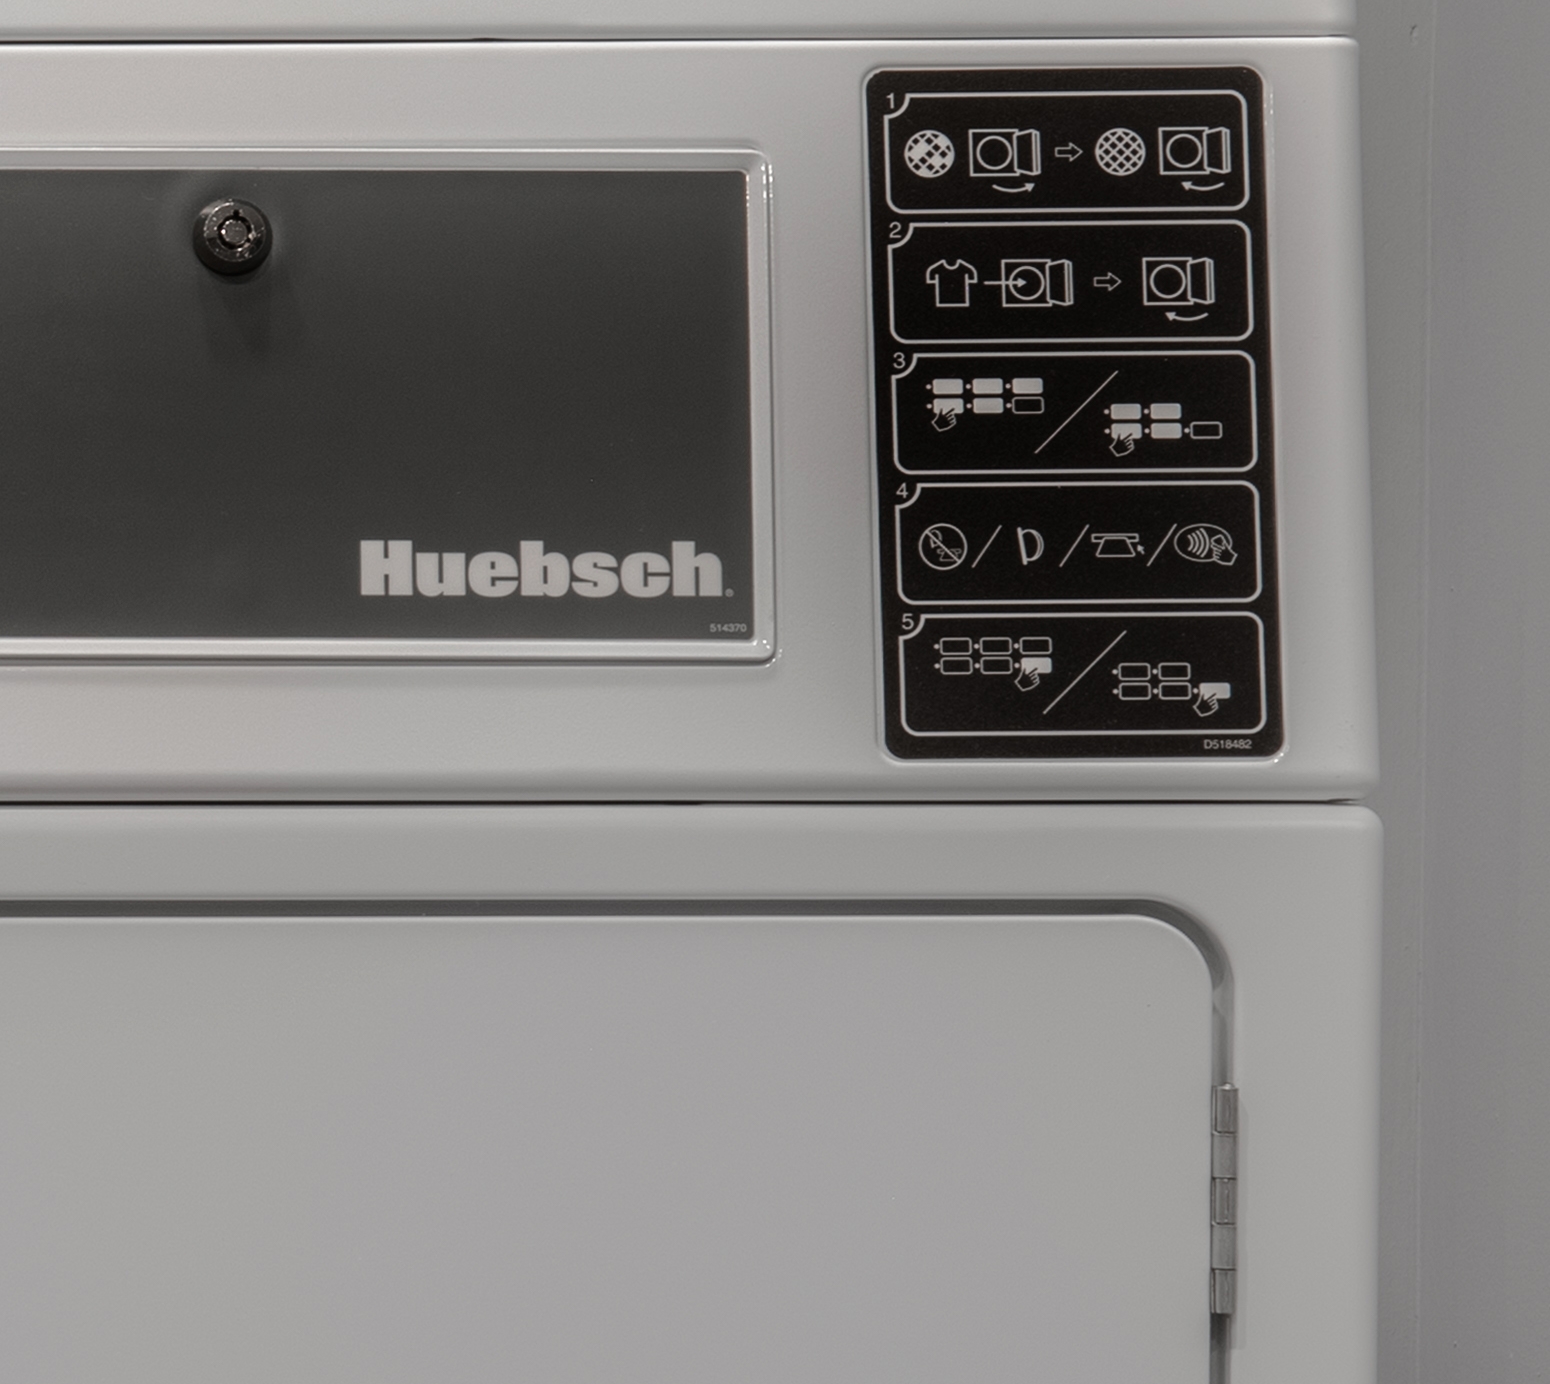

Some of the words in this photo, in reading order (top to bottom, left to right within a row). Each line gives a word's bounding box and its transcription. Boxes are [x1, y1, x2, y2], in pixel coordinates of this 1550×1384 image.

[886, 93, 895, 109] 1
[888, 222, 902, 238] 2
[892, 353, 906, 369] 3
[895, 483, 909, 499] 4
[359, 539, 724, 599] Huebsch
[901, 614, 914, 630] 5
